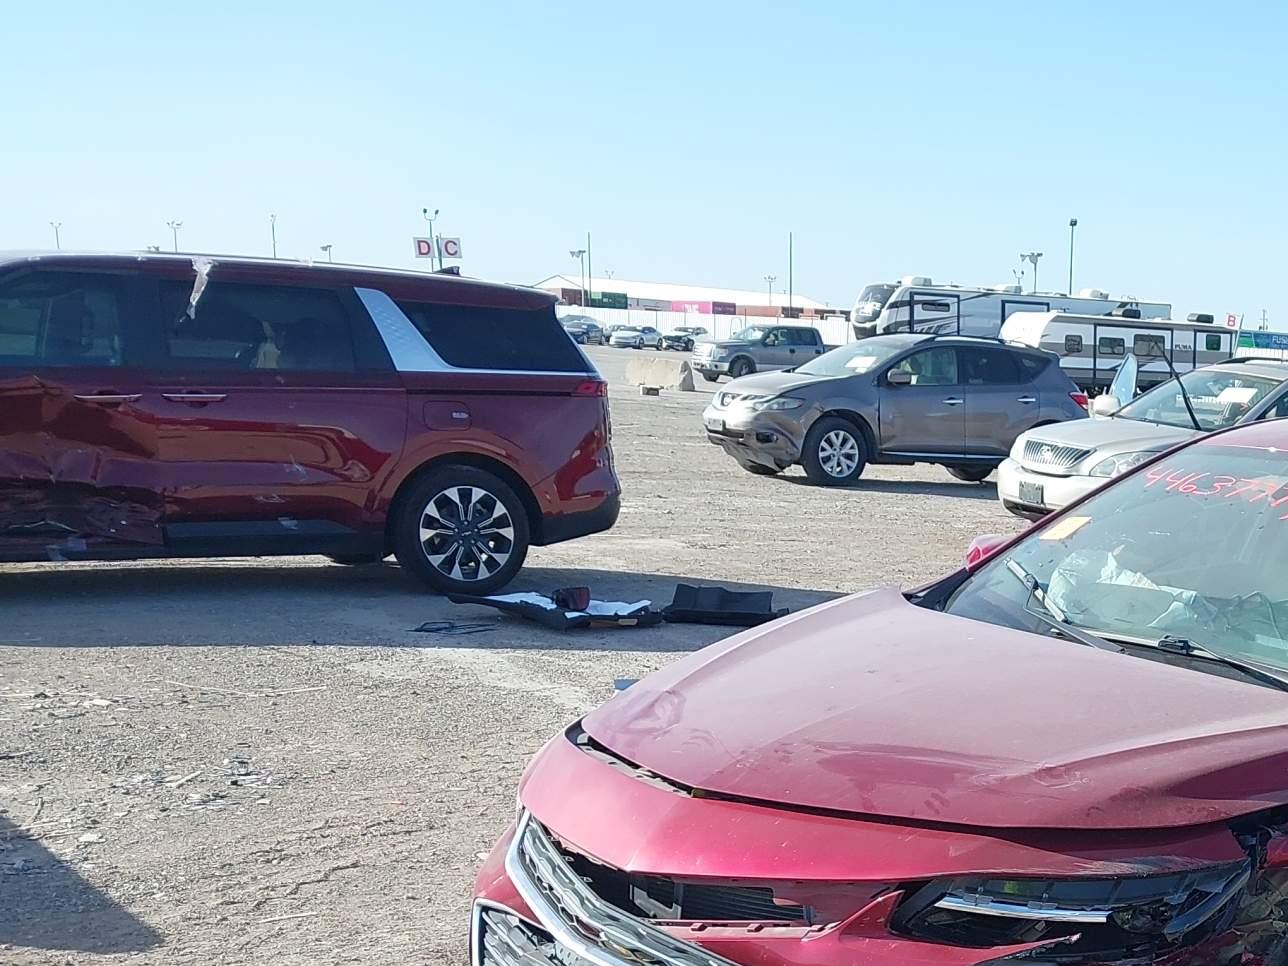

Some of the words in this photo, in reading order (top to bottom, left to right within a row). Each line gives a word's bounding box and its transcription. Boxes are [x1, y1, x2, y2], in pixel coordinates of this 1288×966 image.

[417, 240, 431, 255] D
[445, 240, 458, 256] C
[1227, 314, 1236, 327] B
[1174, 343, 1192, 351] PUMA
